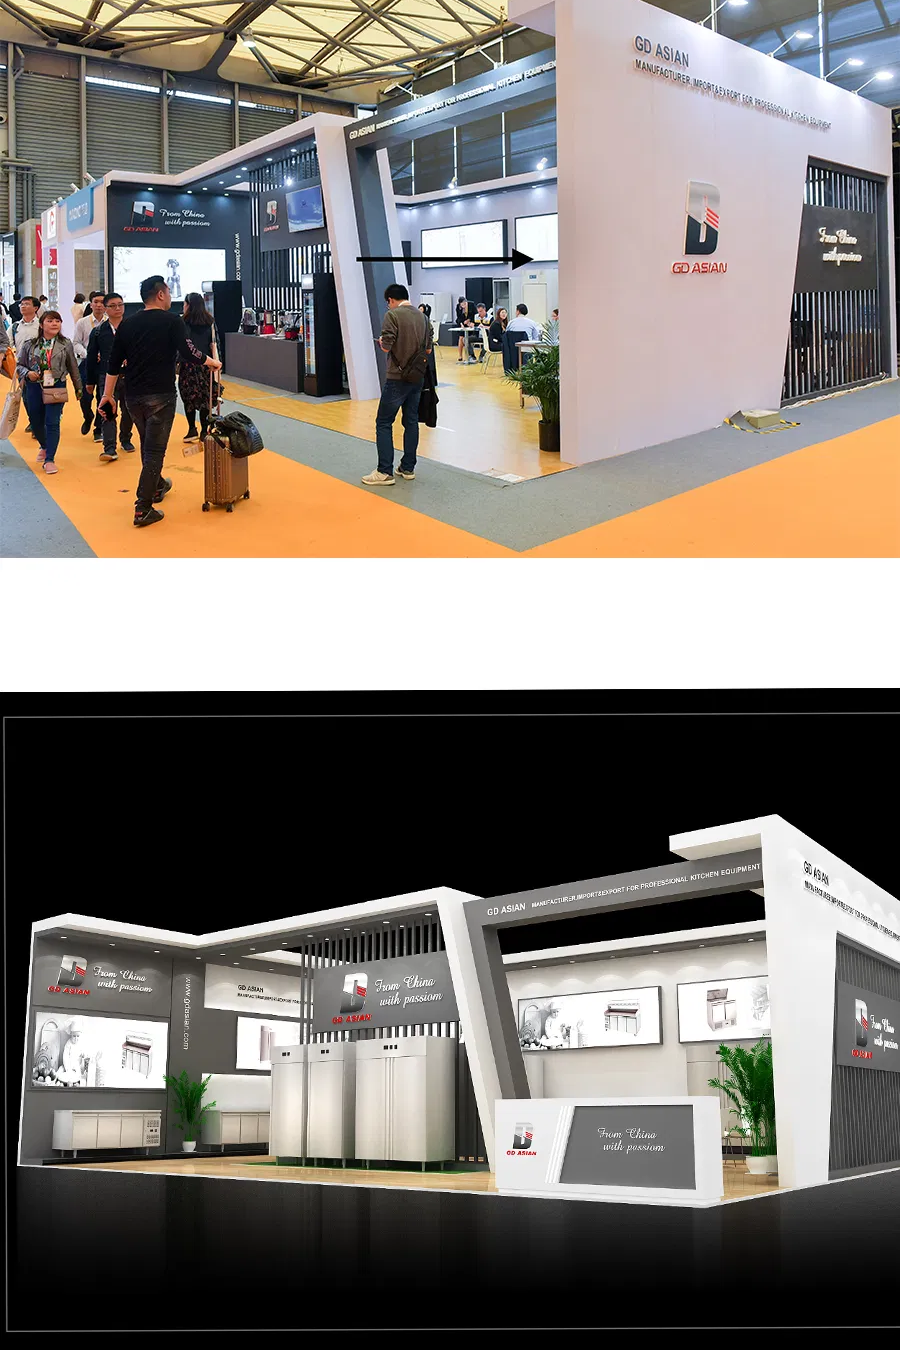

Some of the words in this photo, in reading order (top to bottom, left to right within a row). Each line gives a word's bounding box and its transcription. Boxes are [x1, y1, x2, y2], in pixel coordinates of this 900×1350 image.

[635, 35, 652, 54] GD
[655, 43, 690, 68] ASIAN
[160, 209, 181, 217] From
[672, 262, 690, 274] GD
[692, 262, 728, 274] ASIAN
[626, 884, 640, 892] FOR
[640, 876, 688, 890] PROFESSIONAL
[690, 870, 719, 881] KITCHEN
[721, 863, 761, 876] EQUIPMENT
[487, 907, 499, 916] GD
[500, 902, 526, 915] ASIAN
[93, 966, 117, 978] From
[119, 969, 147, 982] China
[97, 979, 118, 989] with
[374, 979, 401, 993] From
[403, 975, 436, 989] China
[62, 987, 91, 996] ASIAN
[379, 992, 401, 1007] with
[345, 1014, 372, 1023] ASIAN
[598, 1127, 623, 1139] From
[625, 1127, 657, 1140] China
[603, 1139, 624, 1151] with
